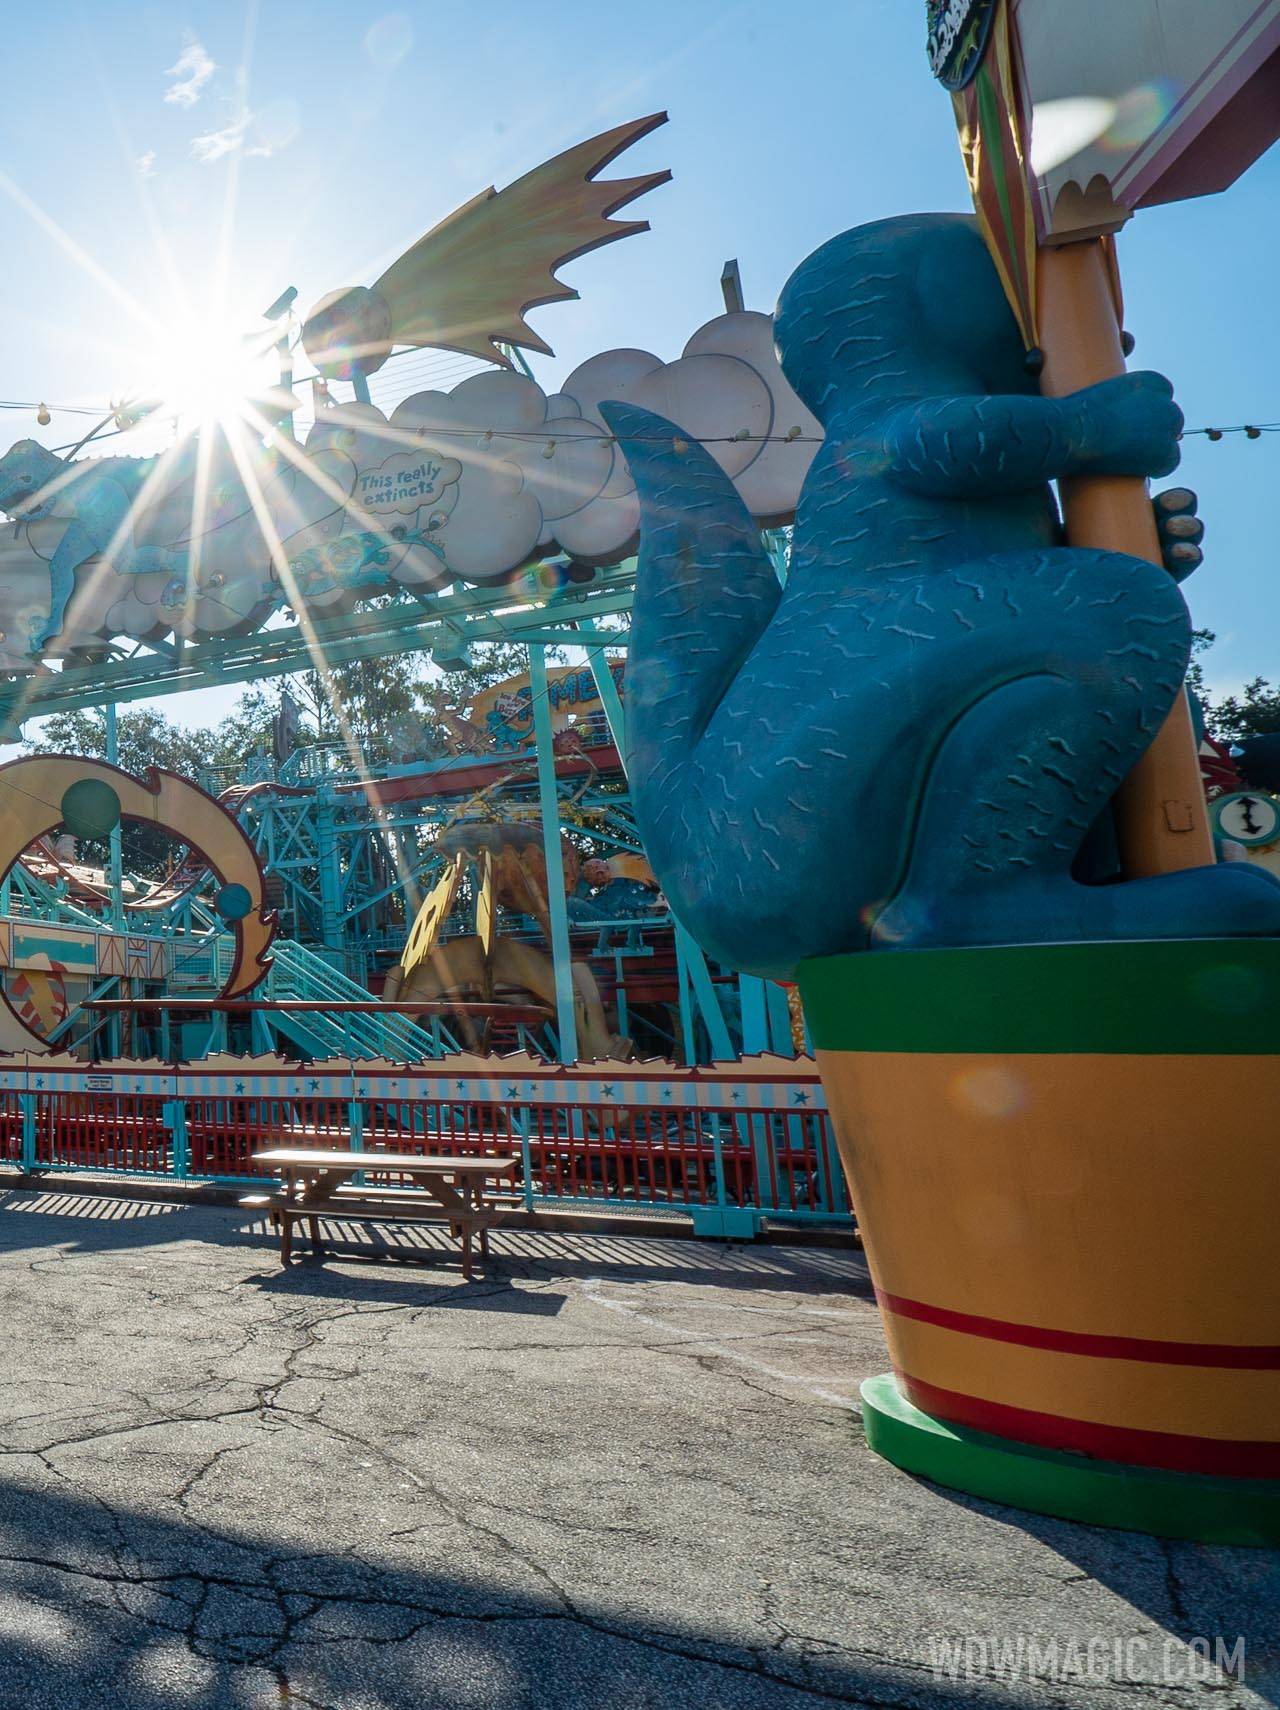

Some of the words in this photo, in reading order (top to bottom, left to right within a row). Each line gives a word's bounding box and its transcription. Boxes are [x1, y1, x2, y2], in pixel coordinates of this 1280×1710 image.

[360, 474, 393, 492] This
[397, 460, 441, 482] really
[364, 480, 434, 506] extincts
